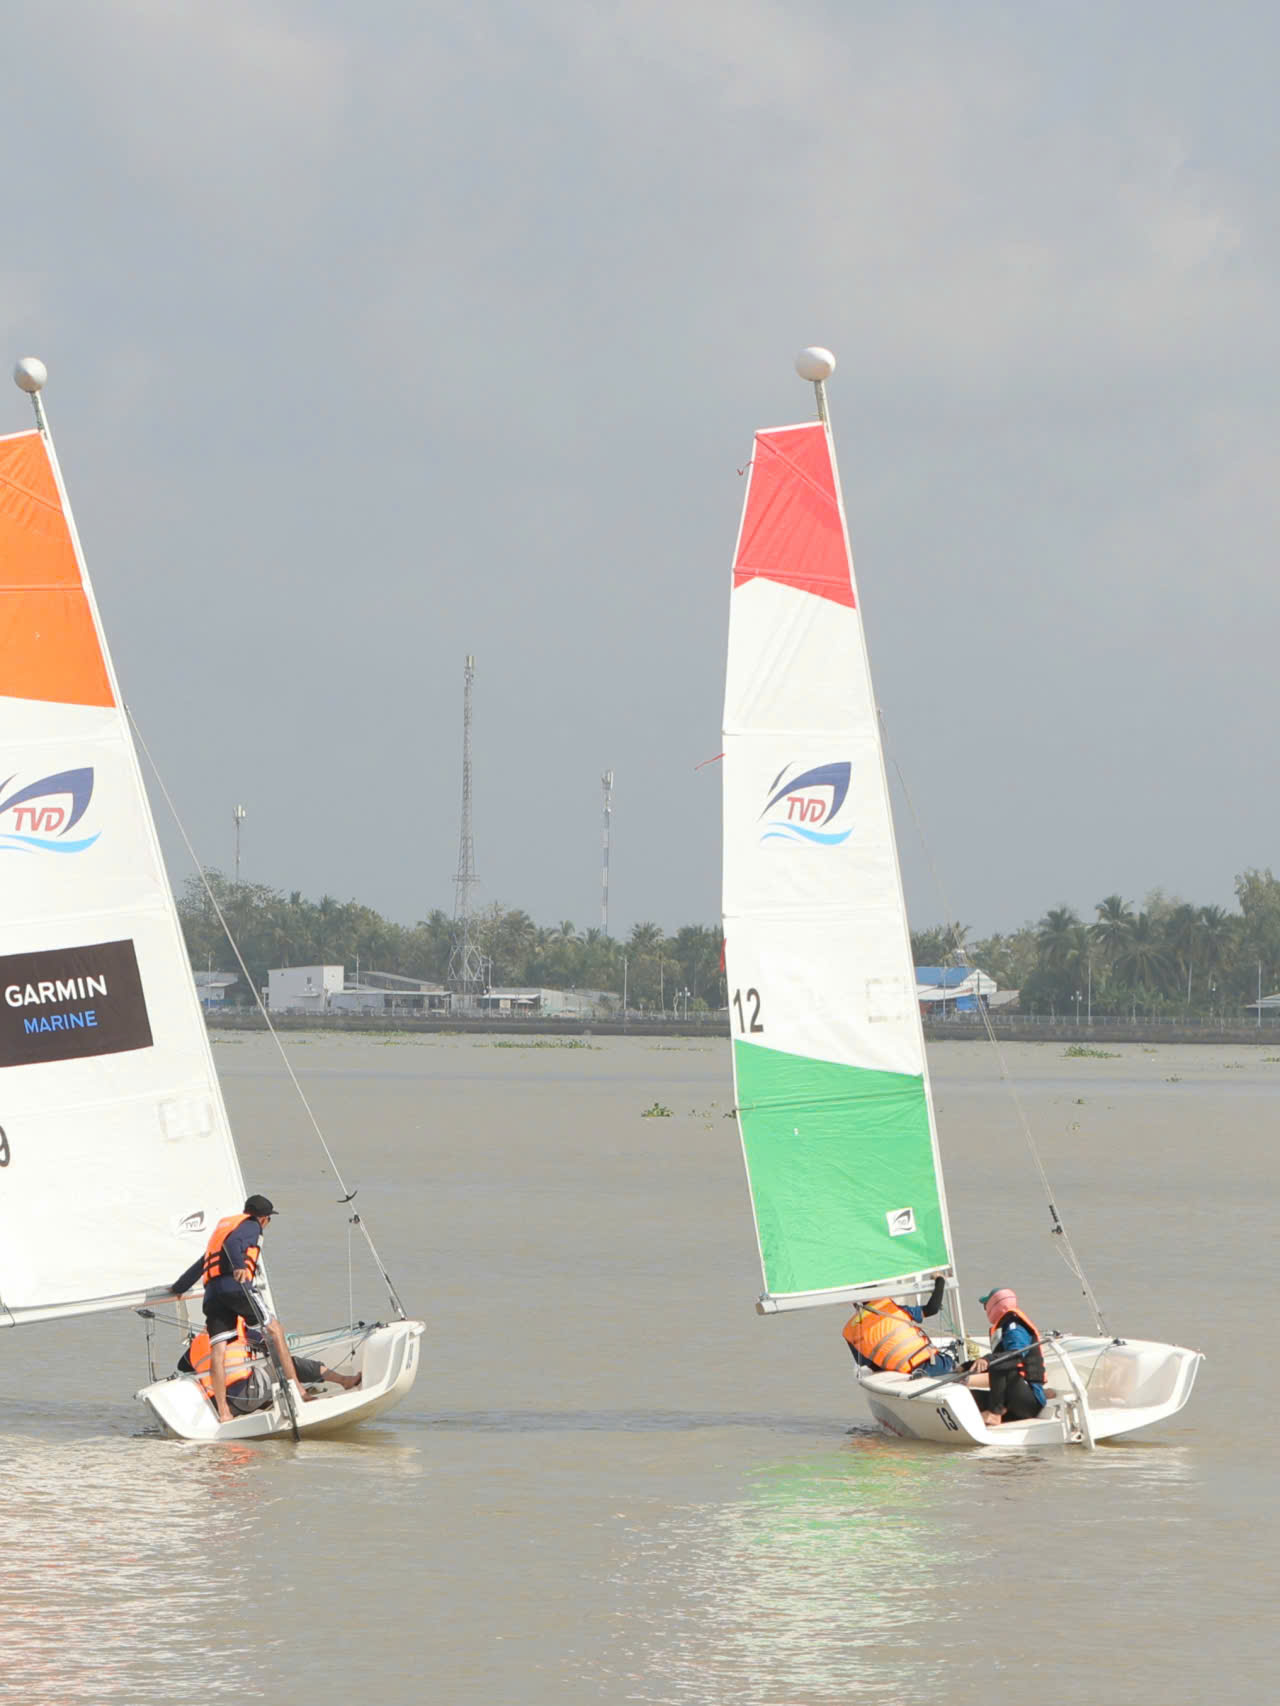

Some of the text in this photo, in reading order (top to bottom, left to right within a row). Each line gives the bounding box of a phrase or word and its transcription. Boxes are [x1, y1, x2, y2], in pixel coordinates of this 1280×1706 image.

[12, 806, 65, 832] TVD
[786, 796, 826, 823] TVD
[4, 974, 108, 1008] GARMIN
[23, 1010, 98, 1034] MARINE
[733, 987, 764, 1033] 12
[936, 1407, 959, 1431] 13
